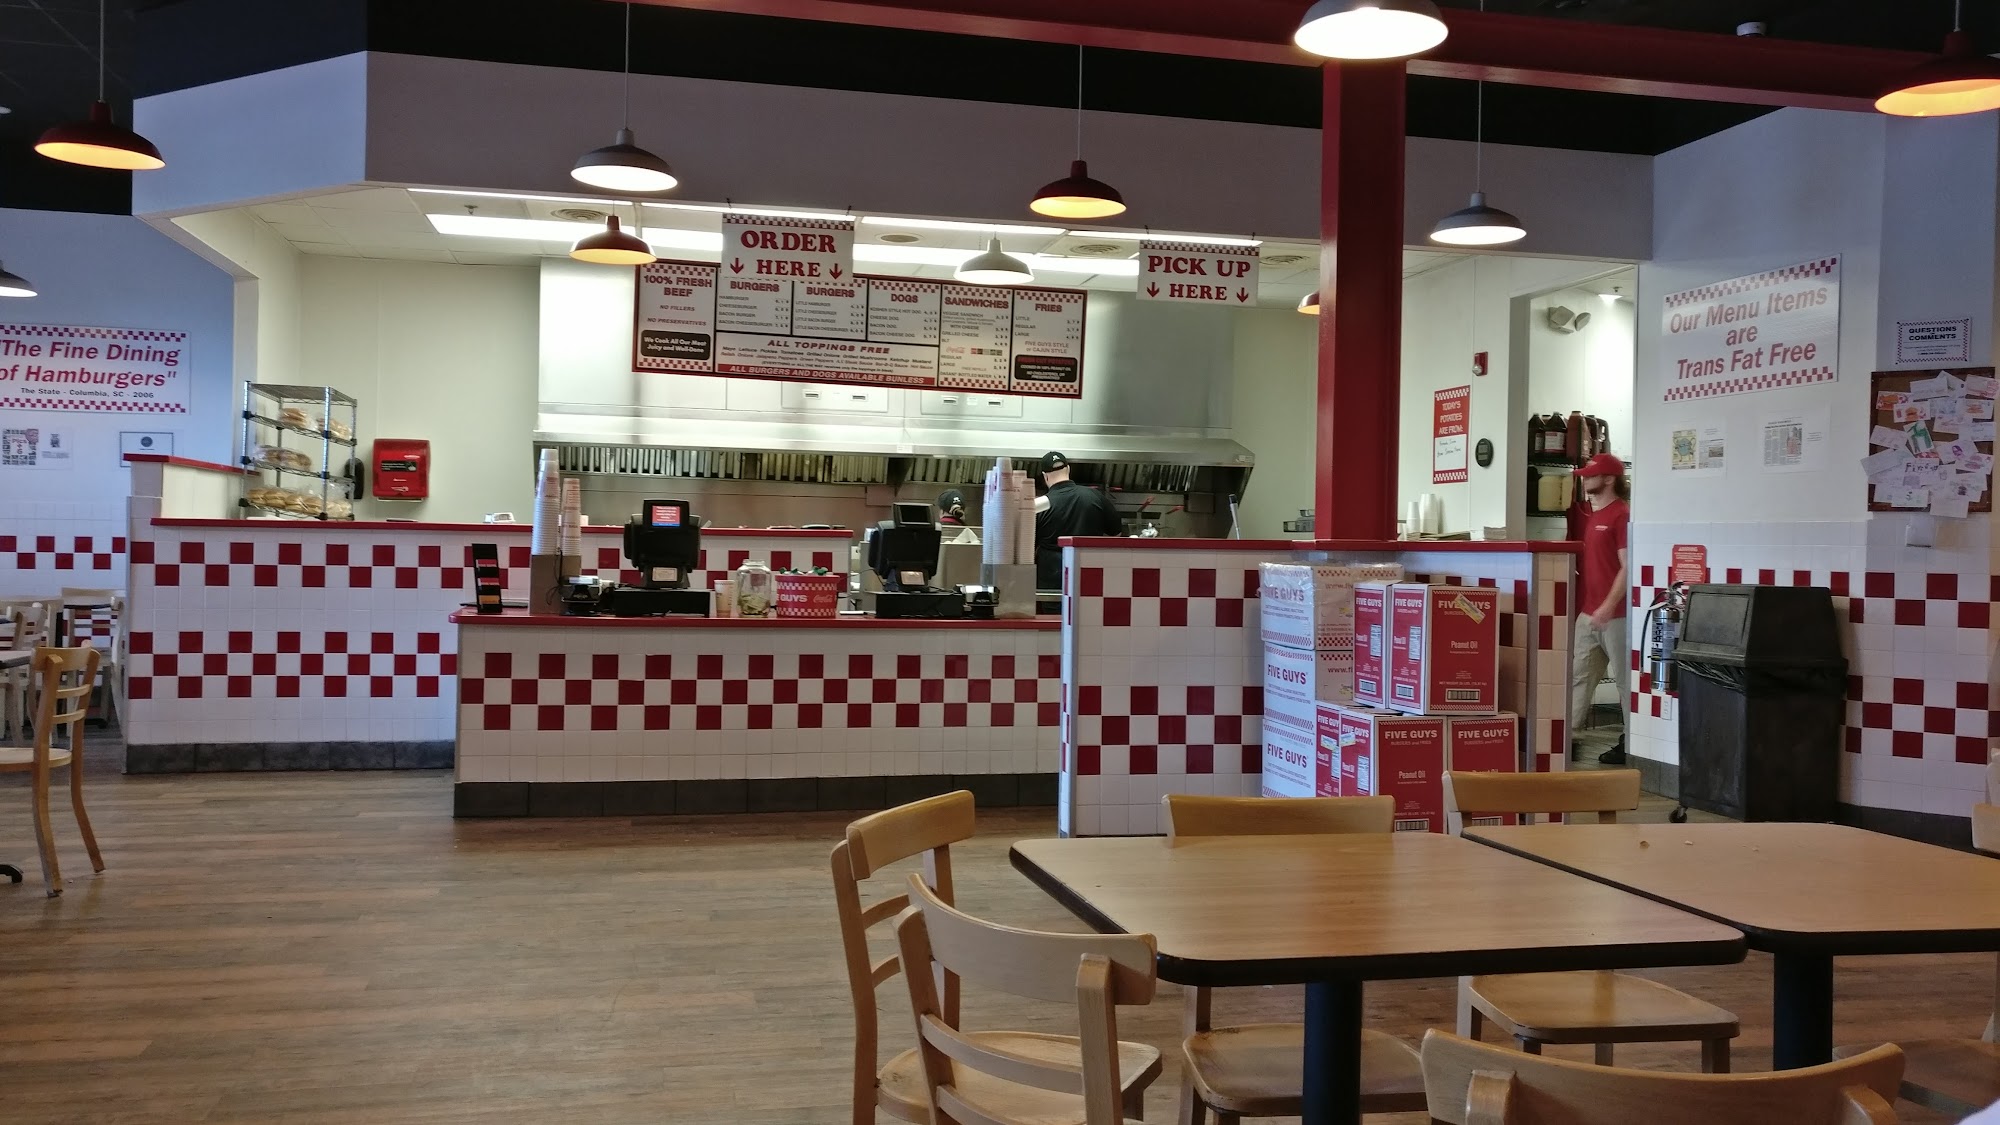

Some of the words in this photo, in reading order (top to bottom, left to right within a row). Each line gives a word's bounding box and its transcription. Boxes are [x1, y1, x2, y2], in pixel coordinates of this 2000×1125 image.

[740, 230, 836, 253] ORDER
[756, 259, 821, 277] HERE
[1147, 255, 1207, 275] PICK
[1217, 260, 1251, 278] UP
[643, 275, 673, 285] 100%
[676, 276, 712, 288] FRESH
[730, 281, 780, 292] BURGERS
[663, 287, 693, 297] BEEF
[806, 286, 855, 298] BURGERS
[1169, 283, 1227, 300] HERE
[891, 294, 918, 303] DOGS
[944, 296, 1009, 309] SANDWICHES
[1035, 303, 1062, 313] FRIES
[1670, 312, 1701, 334] Our
[1706, 301, 1759, 327] Menu
[1766, 287, 1828, 315] Items
[658, 318, 707, 326] PRESERVATIVES
[1726, 325, 1758, 346] are
[1909, 326, 1957, 334] QUESTIONS
[1909, 333, 1956, 341] COMMENTS
[647, 344, 662, 352] Juicy
[795, 341, 855, 352] TOPPINGS
[860, 346, 890, 354] FREE
[49, 341, 99, 359] Fine
[106, 343, 181, 367] Dining
[1677, 357, 1725, 380] Trans
[1730, 347, 1763, 371] Fat
[1769, 342, 1816, 366] Free
[0, 364, 20, 381] of
[25, 365, 177, 389] Hamburgers"
[730, 365, 747, 373] ALL
[748, 366, 790, 376] BURGERS
[792, 369, 811, 377] AND
[812, 371, 837, 379] DOGS
[839, 372, 884, 381] AVAILABLE
[886, 375, 924, 384] BUNLESS
[21, 387, 35, 395] The
[69, 389, 110, 398] Columbia,
[133, 391, 155, 399] 2006
[1440, 412, 1463, 423] POTATOES
[1438, 426, 1449, 435] ARE
[780, 593, 808, 603] GUYS
[1280, 588, 1305, 601] GUYS
[1355, 597, 1367, 606] FIVE
[1367, 598, 1382, 608] GUYS
[1395, 598, 1407, 607] FIVE
[1407, 598, 1423, 608] GUYS
[1469, 601, 1491, 610] UYS
[1450, 640, 1469, 649] Peanut
[1469, 641, 1478, 649] Oil
[1267, 663, 1281, 680] FIVE
[1282, 668, 1307, 685] GUYS
[1317, 715, 1329, 725] FIVE
[1342, 724, 1354, 733] FIVE
[1355, 727, 1369, 738] GUYS
[1384, 730, 1408, 739] FIVE
[1410, 729, 1438, 739] GUYS
[1458, 730, 1481, 739] FIVE
[1482, 728, 1510, 738] GUYS
[1267, 743, 1283, 760] FIVE
[1285, 749, 1307, 769] GUYS
[1398, 770, 1418, 779] Peanut
[1418, 770, 1426, 778] Oil
